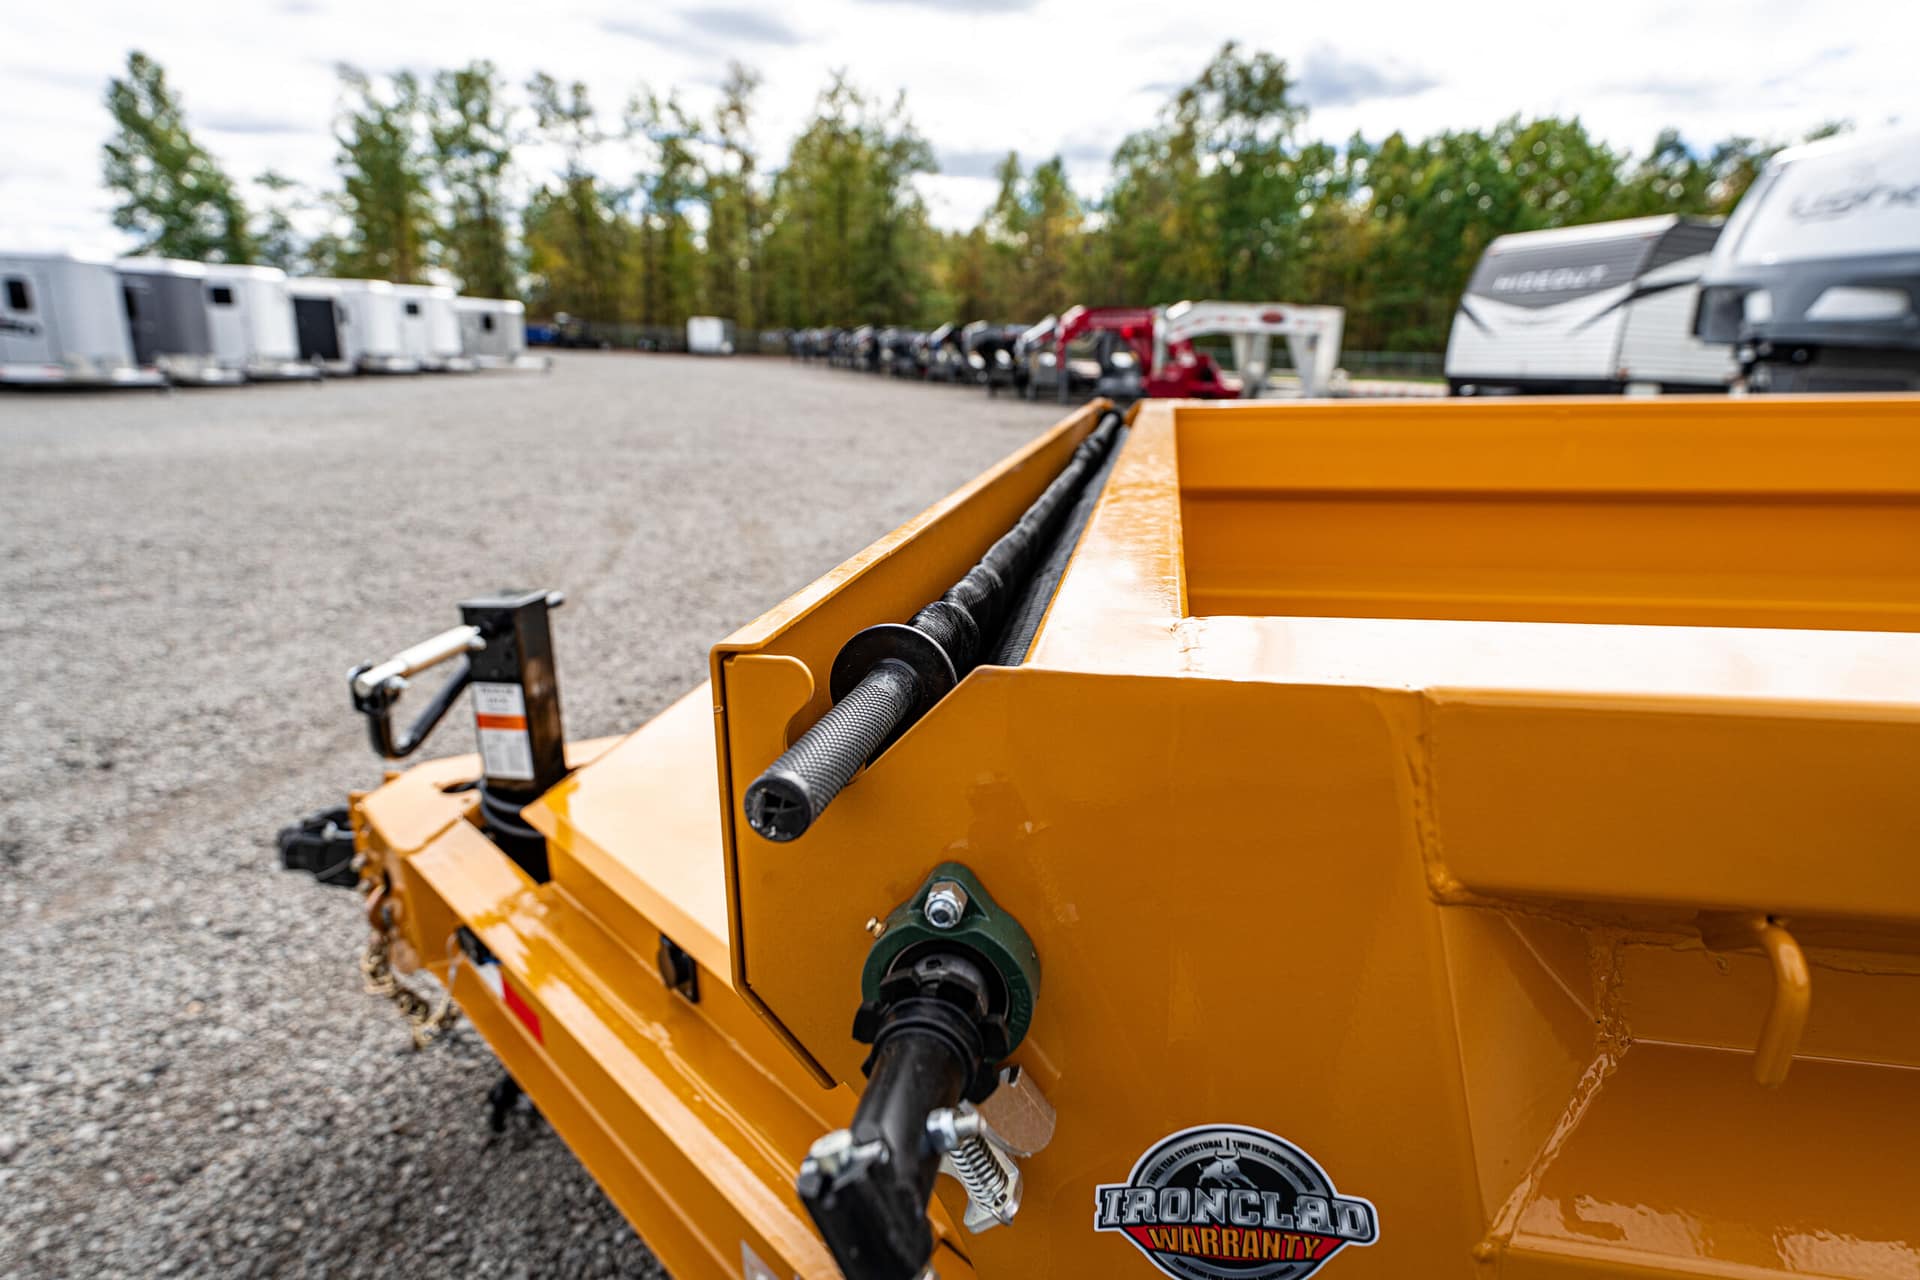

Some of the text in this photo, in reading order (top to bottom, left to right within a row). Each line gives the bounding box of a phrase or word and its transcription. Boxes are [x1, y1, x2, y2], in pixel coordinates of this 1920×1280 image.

[1160, 1154, 1178, 1171] YEAR
[1174, 1139, 1223, 1160] STRUCTURAL
[1232, 1140, 1251, 1151] TWO
[1251, 1144, 1270, 1156] YEAR
[1101, 1187, 1373, 1239] IRONCLAD
[1147, 1227, 1322, 1260] WARRANTY
